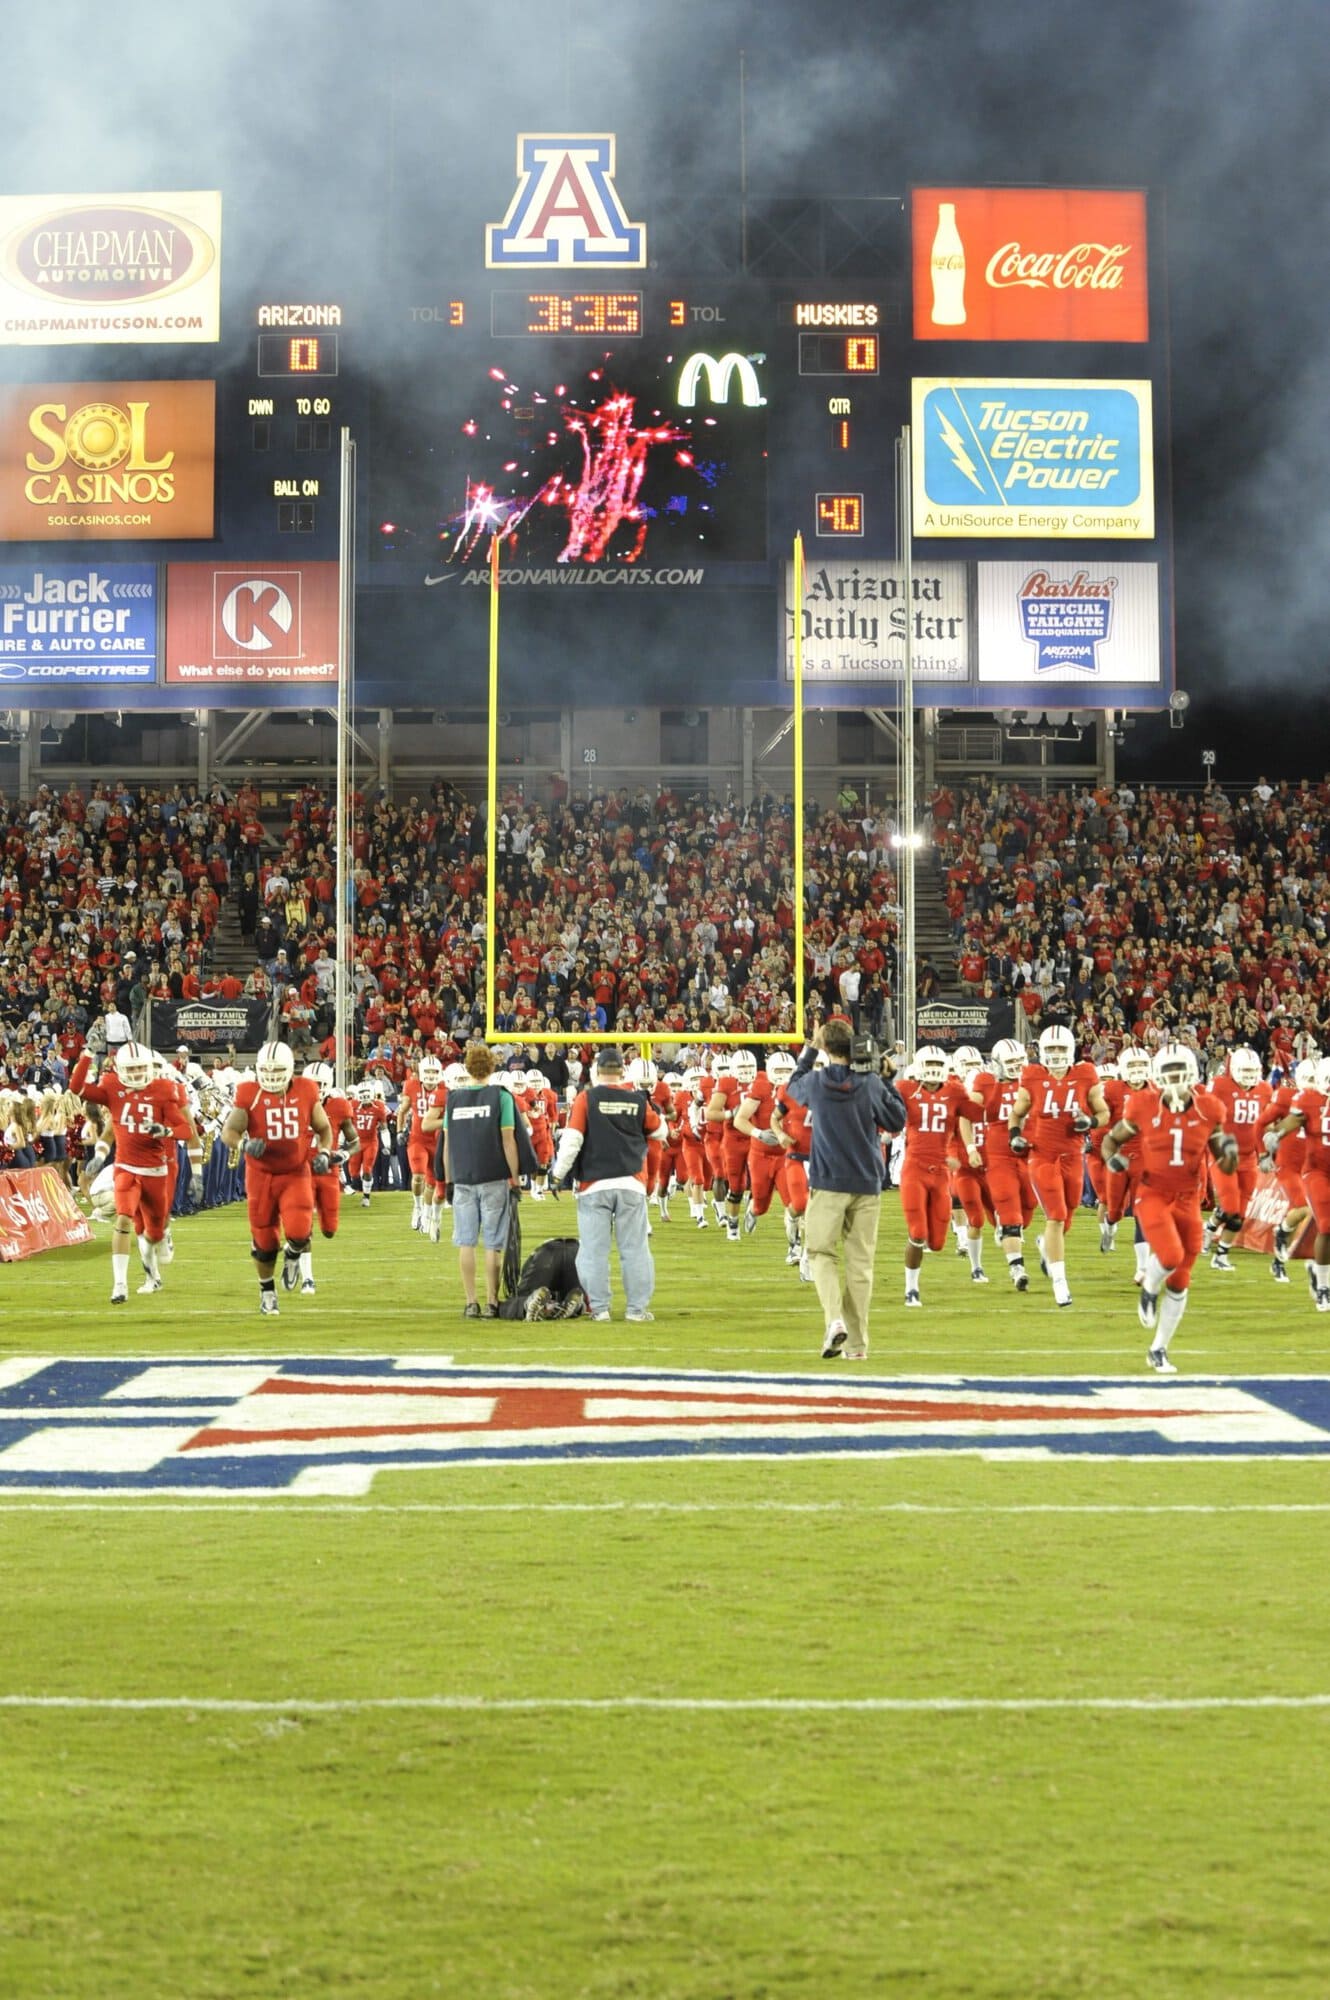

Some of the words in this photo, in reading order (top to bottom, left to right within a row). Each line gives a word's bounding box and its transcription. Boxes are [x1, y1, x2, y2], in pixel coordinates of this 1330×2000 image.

[485, 133, 647, 268] A
[33, 230, 175, 268] CHAPMAN
[36, 268, 173, 283] AUTOMOTIVE
[985, 242, 1131, 289] Coca-Cola
[4, 316, 203, 331] CHAPMANTUCSON.COM
[258, 305, 342, 327] ARIZONA
[409, 307, 444, 322] TOL
[450, 302, 463, 325] 3
[528, 295, 638, 332] 3:35
[670, 302, 685, 325] 3
[691, 307, 725, 322] TOL
[796, 304, 878, 325] HUSKIES
[290, 339, 318, 371] 0
[847, 338, 875, 369] 0
[249, 399, 274, 415] DWN
[296, 398, 311, 415] TO
[314, 398, 330, 415] GO
[829, 398, 851, 414] QTR
[979, 402, 1090, 432] Tucson
[26, 402, 175, 472] SOL
[842, 421, 848, 448] 1
[990, 432, 1119, 460] Electric
[1004, 461, 1119, 490] Power
[25, 472, 175, 504] CASINOS
[274, 480, 300, 496] BALL
[302, 480, 319, 496] ON
[47, 514, 151, 526] SOLCASINOS.COM
[820, 499, 859, 530] 40
[924, 514, 935, 526] A
[939, 514, 1013, 527] UniSource
[1018, 514, 1068, 530] Energy
[1072, 515, 1140, 531] Company
[24, 572, 111, 604] Jack
[462, 568, 703, 585] ARZONAWILDCATS.COM
[806, 567, 943, 602] Arizona
[3, 603, 131, 633] Furrier
[1027, 604, 1104, 615] OFFICIAL
[785, 607, 879, 648] Daily
[888, 607, 964, 641] Star
[1027, 617, 1104, 628] TAILGATE
[1028, 628, 1104, 637] HEADQUARTERS
[0, 639, 26, 651] IRE
[31, 639, 44, 651] &
[50, 638, 96, 651] AUTO
[100, 638, 145, 650] CARE
[1041, 646, 1092, 656] ARIZONA
[27, 665, 151, 677] COOPERTIRES
[178, 665, 213, 676] What
[216, 664, 243, 676] else
[247, 664, 265, 676] do
[267, 666, 290, 678] you
[293, 663, 335, 675] need?
[788, 654, 814, 670] I's
[821, 659, 832, 670] a
[838, 654, 903, 670] Tucson
[912, 654, 963, 674] thing.
[584, 749, 597, 762] 28
[1203, 751, 1215, 764] 29
[178, 1012, 217, 1020] AMERICAN
[417, 1099, 428, 1117] 9
[452, 1105, 491, 1120] ESPN
[598, 1101, 639, 1116] ESPN
[1043, 1089, 1079, 1119] 44
[1233, 1100, 1260, 1124] 68
[120, 1102, 154, 1133] 43
[265, 1107, 300, 1140] 55
[356, 1114, 374, 1130] 27
[918, 1103, 947, 1132] 12
[972, 1121, 989, 1147] 6
[1168, 1128, 1185, 1166] 1
